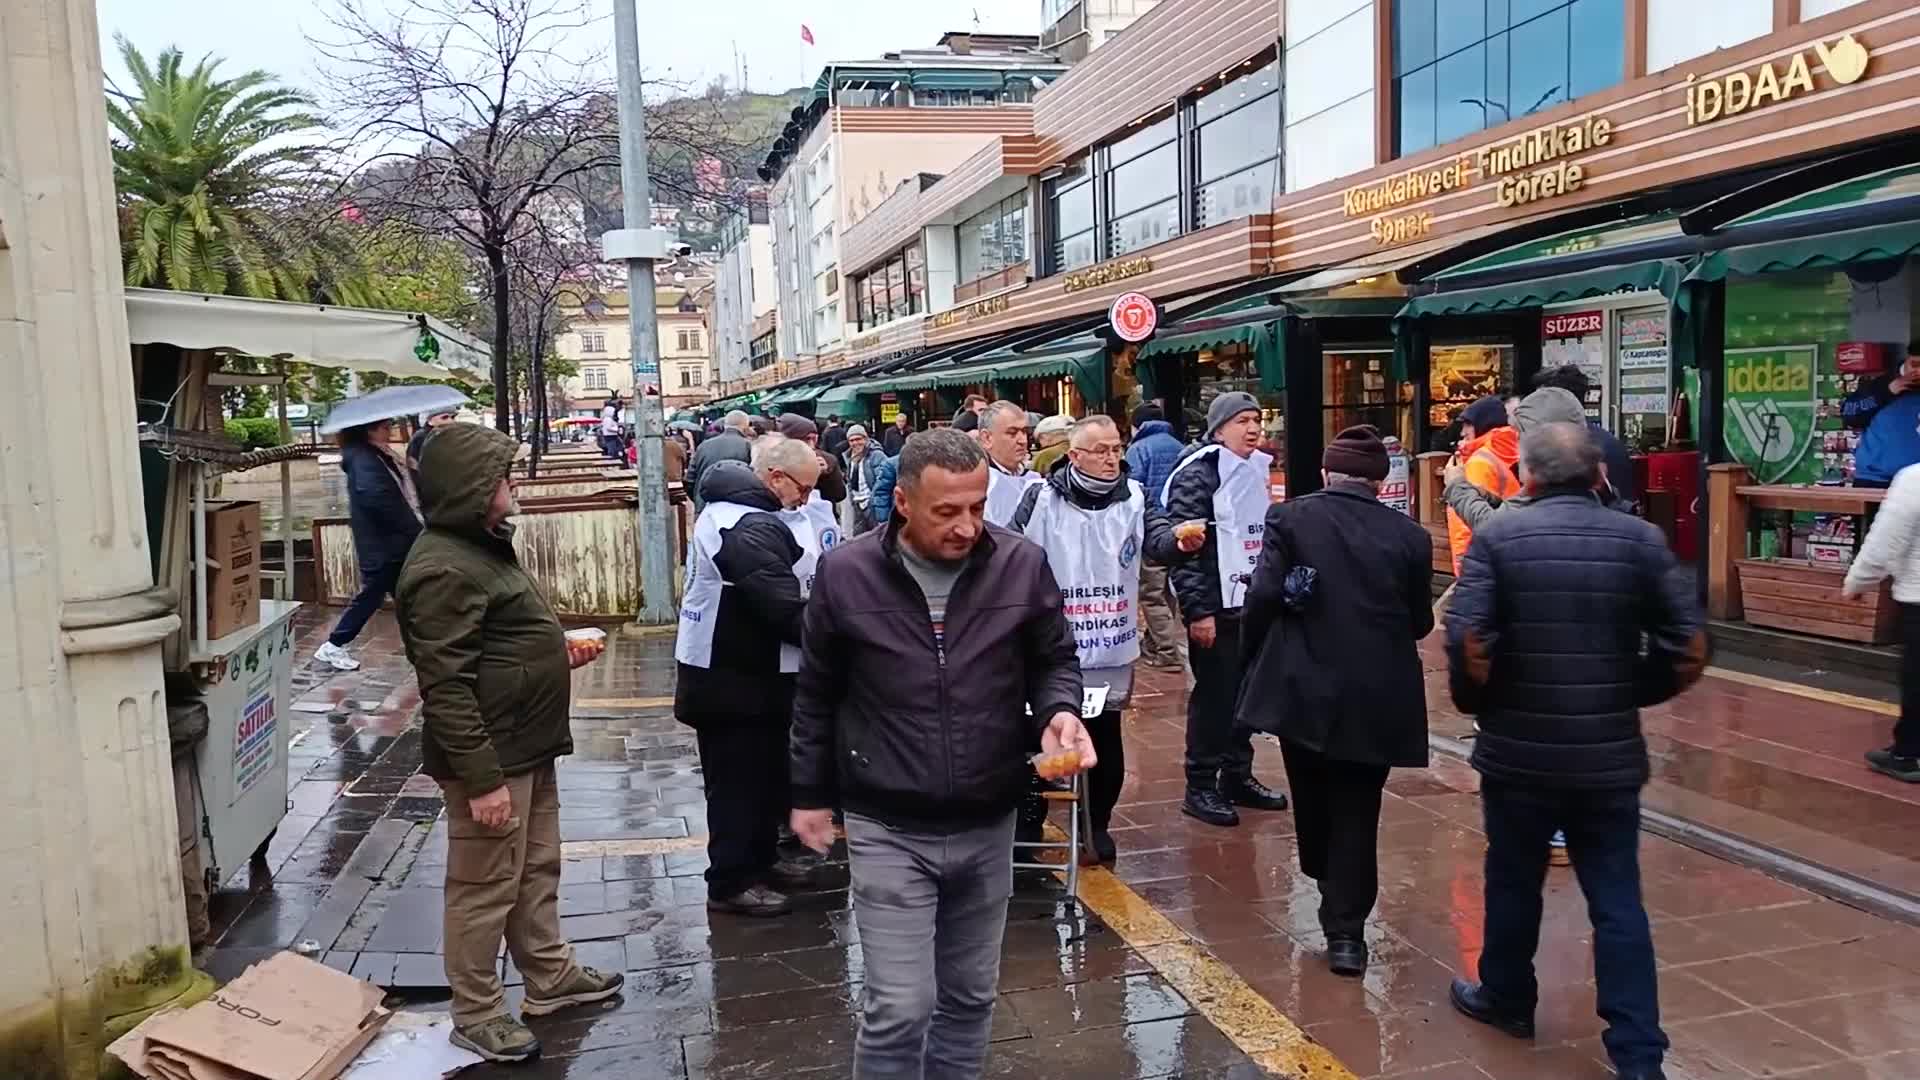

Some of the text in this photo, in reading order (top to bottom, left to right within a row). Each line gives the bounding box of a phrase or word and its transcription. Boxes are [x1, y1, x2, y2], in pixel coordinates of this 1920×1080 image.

[1687, 53, 1814, 126] İDDAA
[1496, 161, 1583, 208] Görele
[1545, 315, 1602, 335] SÜZER
[1727, 357, 1810, 393] iddaa
[1061, 584, 1126, 599] BİRLEŞİK
[1062, 599, 1129, 616] MEKLİLER
[1066, 616, 1128, 633] ENDİKASI
[237, 697, 275, 746] SATILIK
